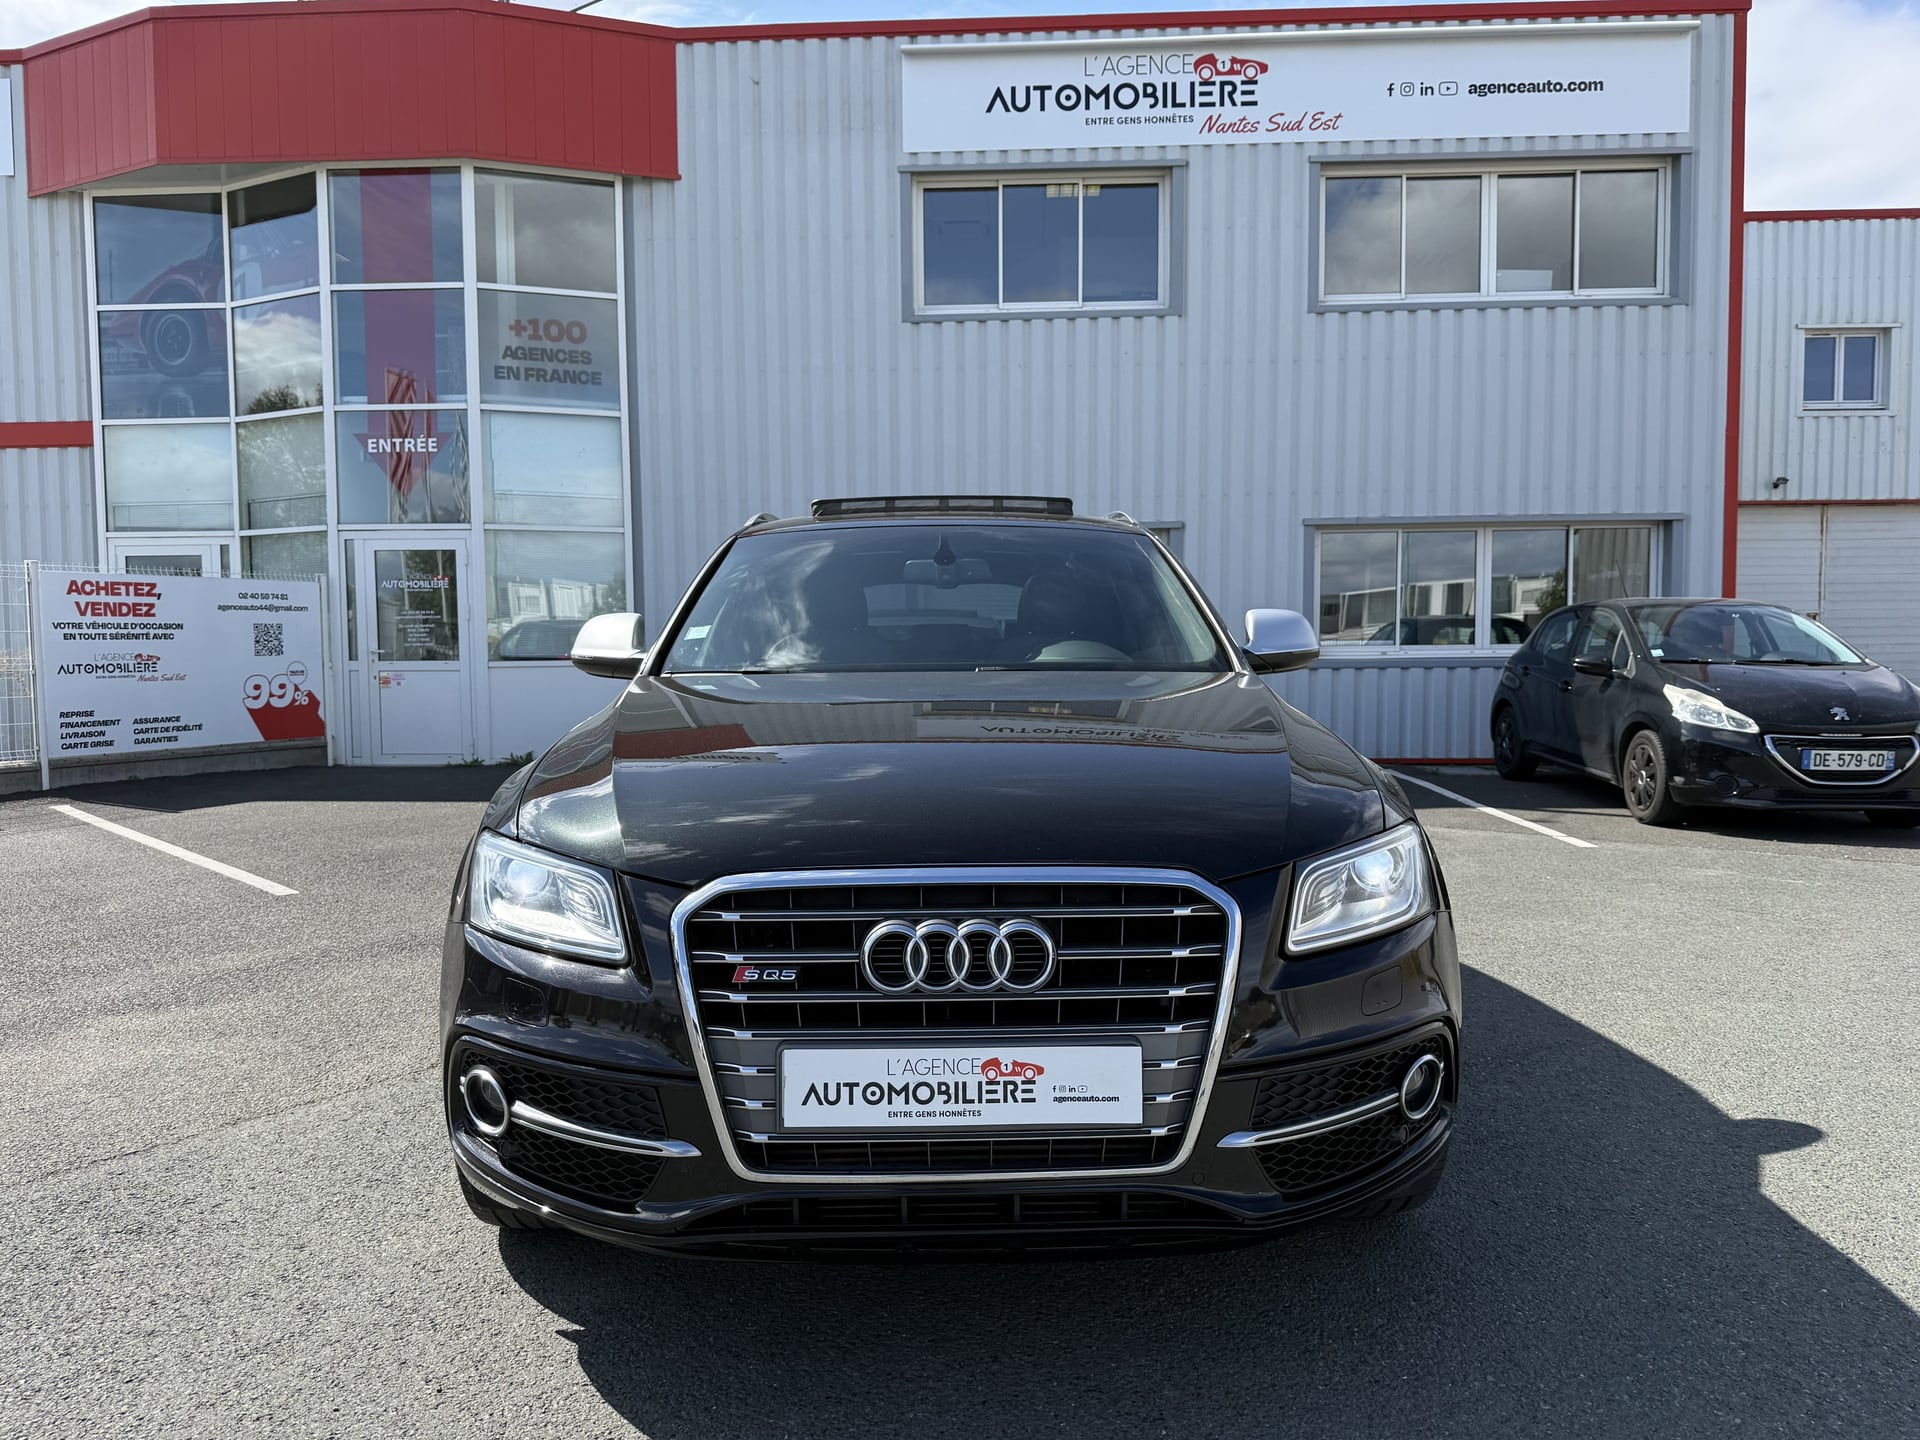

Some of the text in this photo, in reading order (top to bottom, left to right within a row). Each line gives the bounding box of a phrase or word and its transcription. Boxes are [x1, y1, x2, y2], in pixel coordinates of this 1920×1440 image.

[1084, 54, 1194, 77] L'AGENCE
[1468, 79, 1604, 97] agenceauto.com
[1085, 113, 1194, 126] ENTRE GENS HONNÊTES
[1199, 111, 1344, 134] Nantes Sud Est
[508, 318, 588, 345] +100
[501, 345, 593, 365] AGENCES
[494, 365, 602, 386] EN FRANCE
[367, 434, 438, 453] ENTRÉE
[66, 580, 162, 600] ACHETEZ,
[238, 592, 248, 600] 02
[249, 592, 259, 600] 40
[75, 601, 156, 617] VENDEZ
[52, 621, 184, 630] VOTRE VÉHICULE D'OCCASION
[108, 631, 151, 640] SÉRÉNITÉ
[243, 674, 309, 709] 99%
[59, 710, 95, 719] REPRISE
[133, 716, 181, 725] ASSURANCE
[60, 719, 121, 729] FINANCEMENT
[133, 723, 203, 735] CARTE DE FIDÉLITÉ
[60, 730, 106, 739] LIVRAISON
[134, 736, 179, 745] GARANTIES
[61, 740, 115, 750] CARTE GRISE
[1813, 753, 1885, 768] DE-579-CD
[887, 1057, 981, 1076] L'AGENCE
[1053, 1095, 1119, 1103] agenceauto.com
[888, 1108, 982, 1118] ENTRE GENS HONNÊTES
